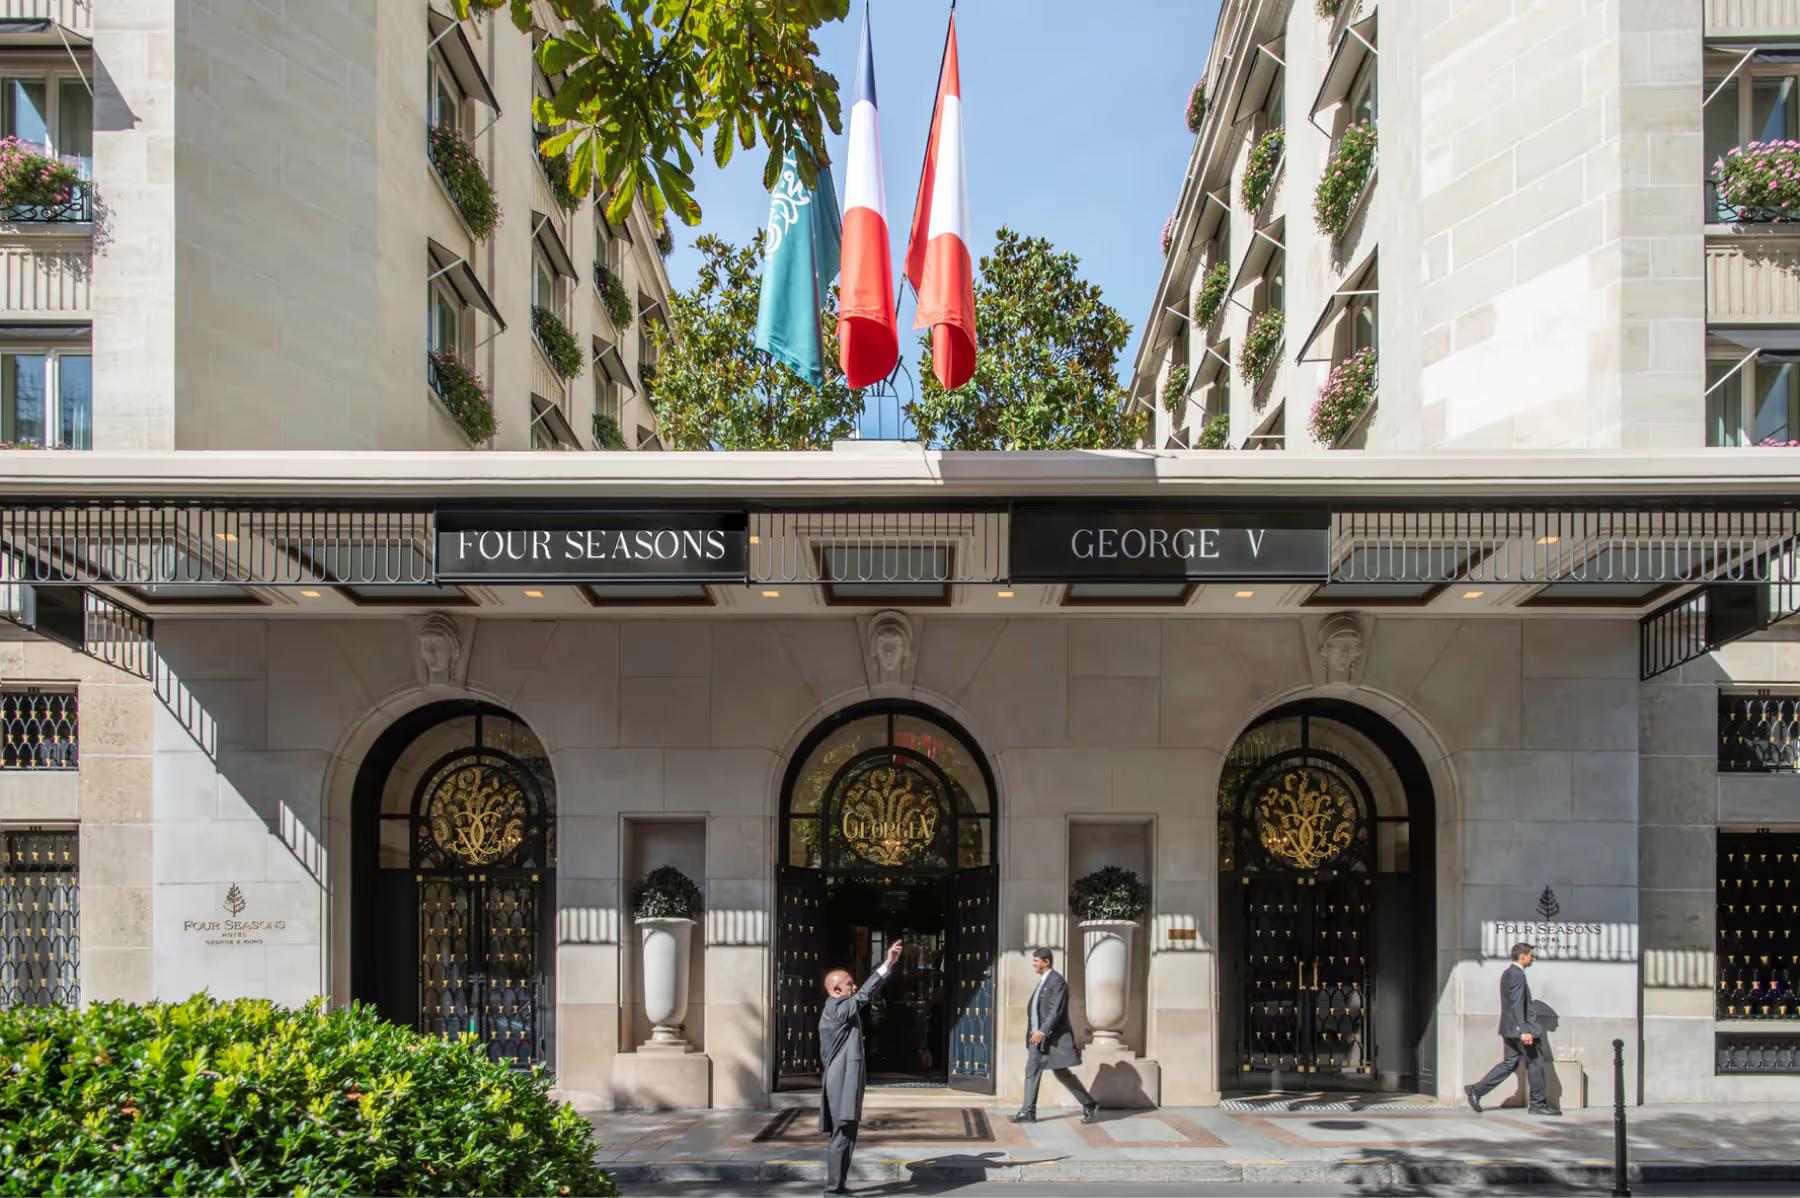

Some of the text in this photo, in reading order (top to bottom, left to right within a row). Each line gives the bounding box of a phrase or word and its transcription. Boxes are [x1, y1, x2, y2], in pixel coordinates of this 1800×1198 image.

[459, 530, 726, 560] FOUR SEASONS
[1071, 528, 1265, 560] GEORGE V
[183, 919, 287, 931] FOUR SEASONS
[1495, 923, 1602, 936] FOUR SEASONS
